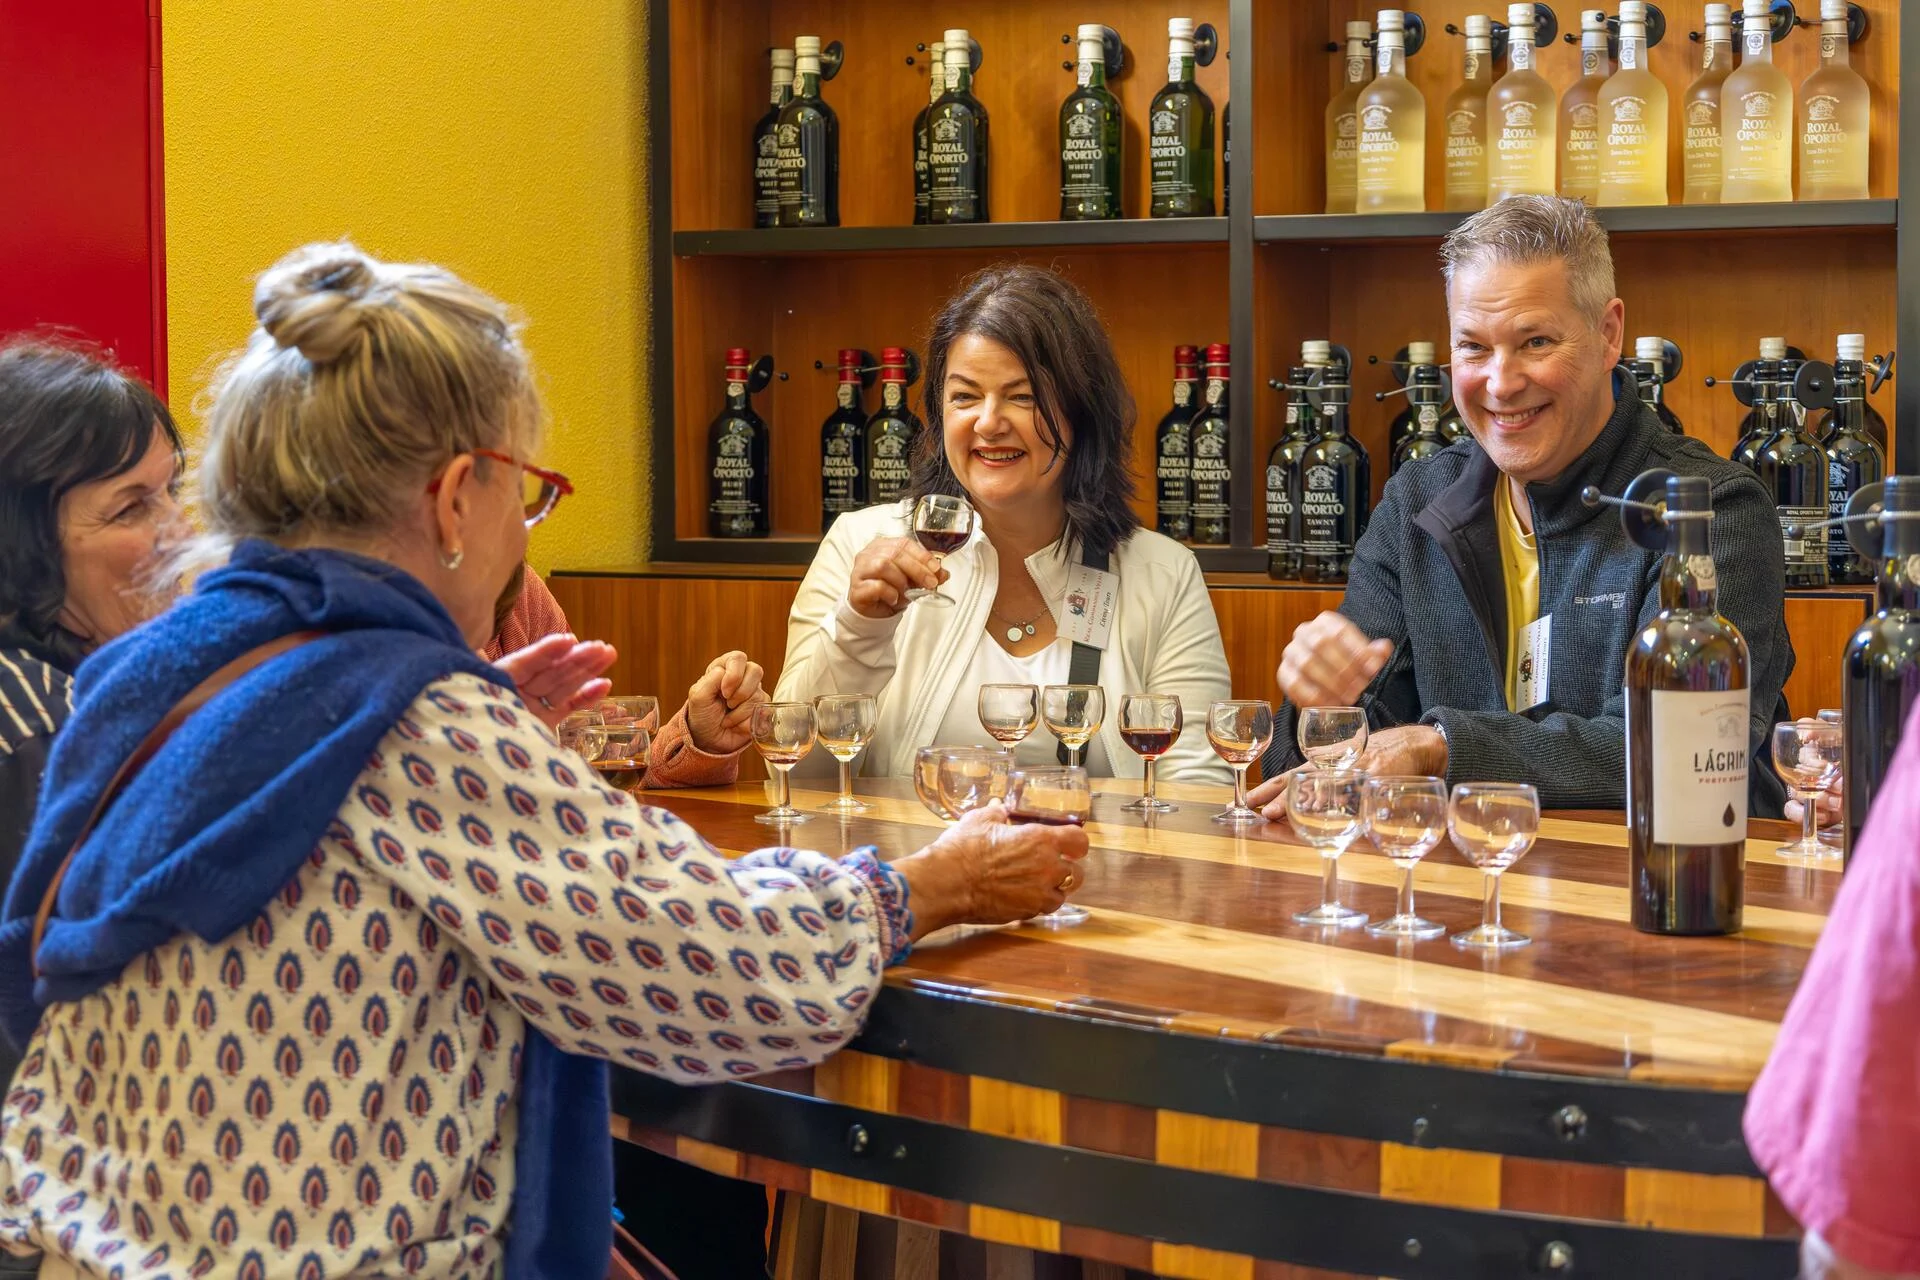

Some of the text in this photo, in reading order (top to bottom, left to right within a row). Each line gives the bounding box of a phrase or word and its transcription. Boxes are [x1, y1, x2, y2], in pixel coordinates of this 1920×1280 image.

[1611, 123, 1648, 135] ROYAL
[1742, 118, 1776, 130] ROYA
[1807, 122, 1842, 134] ROYAL
[1361, 131, 1396, 143] ROYAL
[1502, 127, 1537, 139] ROYAL
[1570, 129, 1598, 141] ROYA
[1687, 127, 1720, 138] ROYAL
[1803, 132, 1848, 145] OPORTO
[1065, 139, 1099, 149] ROYAL
[1151, 135, 1182, 147] ROYAL
[1336, 138, 1357, 149] ROY
[1358, 140, 1400, 153] OPORTO
[1447, 136, 1479, 147] ROYAL
[1566, 140, 1598, 152] OPORT
[932, 142, 964, 153] ROYAL
[1150, 145, 1186, 159] PORTO
[929, 153, 968, 163] OPORTO
[1062, 149, 1103, 160] OPORTO
[757, 157, 779, 168] ROY
[778, 157, 806, 168] PORTO
[1153, 160, 1178, 168] WHITE
[716, 456, 751, 468] ROYAL
[823, 455, 854, 467] ROYAL
[873, 457, 907, 470] ROYAL
[1193, 457, 1228, 470] ROYAL
[713, 467, 755, 478] OPORTO
[869, 468, 911, 481] OPORTO
[1190, 468, 1232, 481] OPORTO
[1198, 483, 1220, 491] RUBY
[1304, 490, 1340, 503] ROYAL
[1829, 490, 1849, 501] YAL
[1301, 503, 1344, 516] OPORTO
[1306, 518, 1336, 526] TAWNY
[1694, 748, 1747, 772] LÁGRIM
